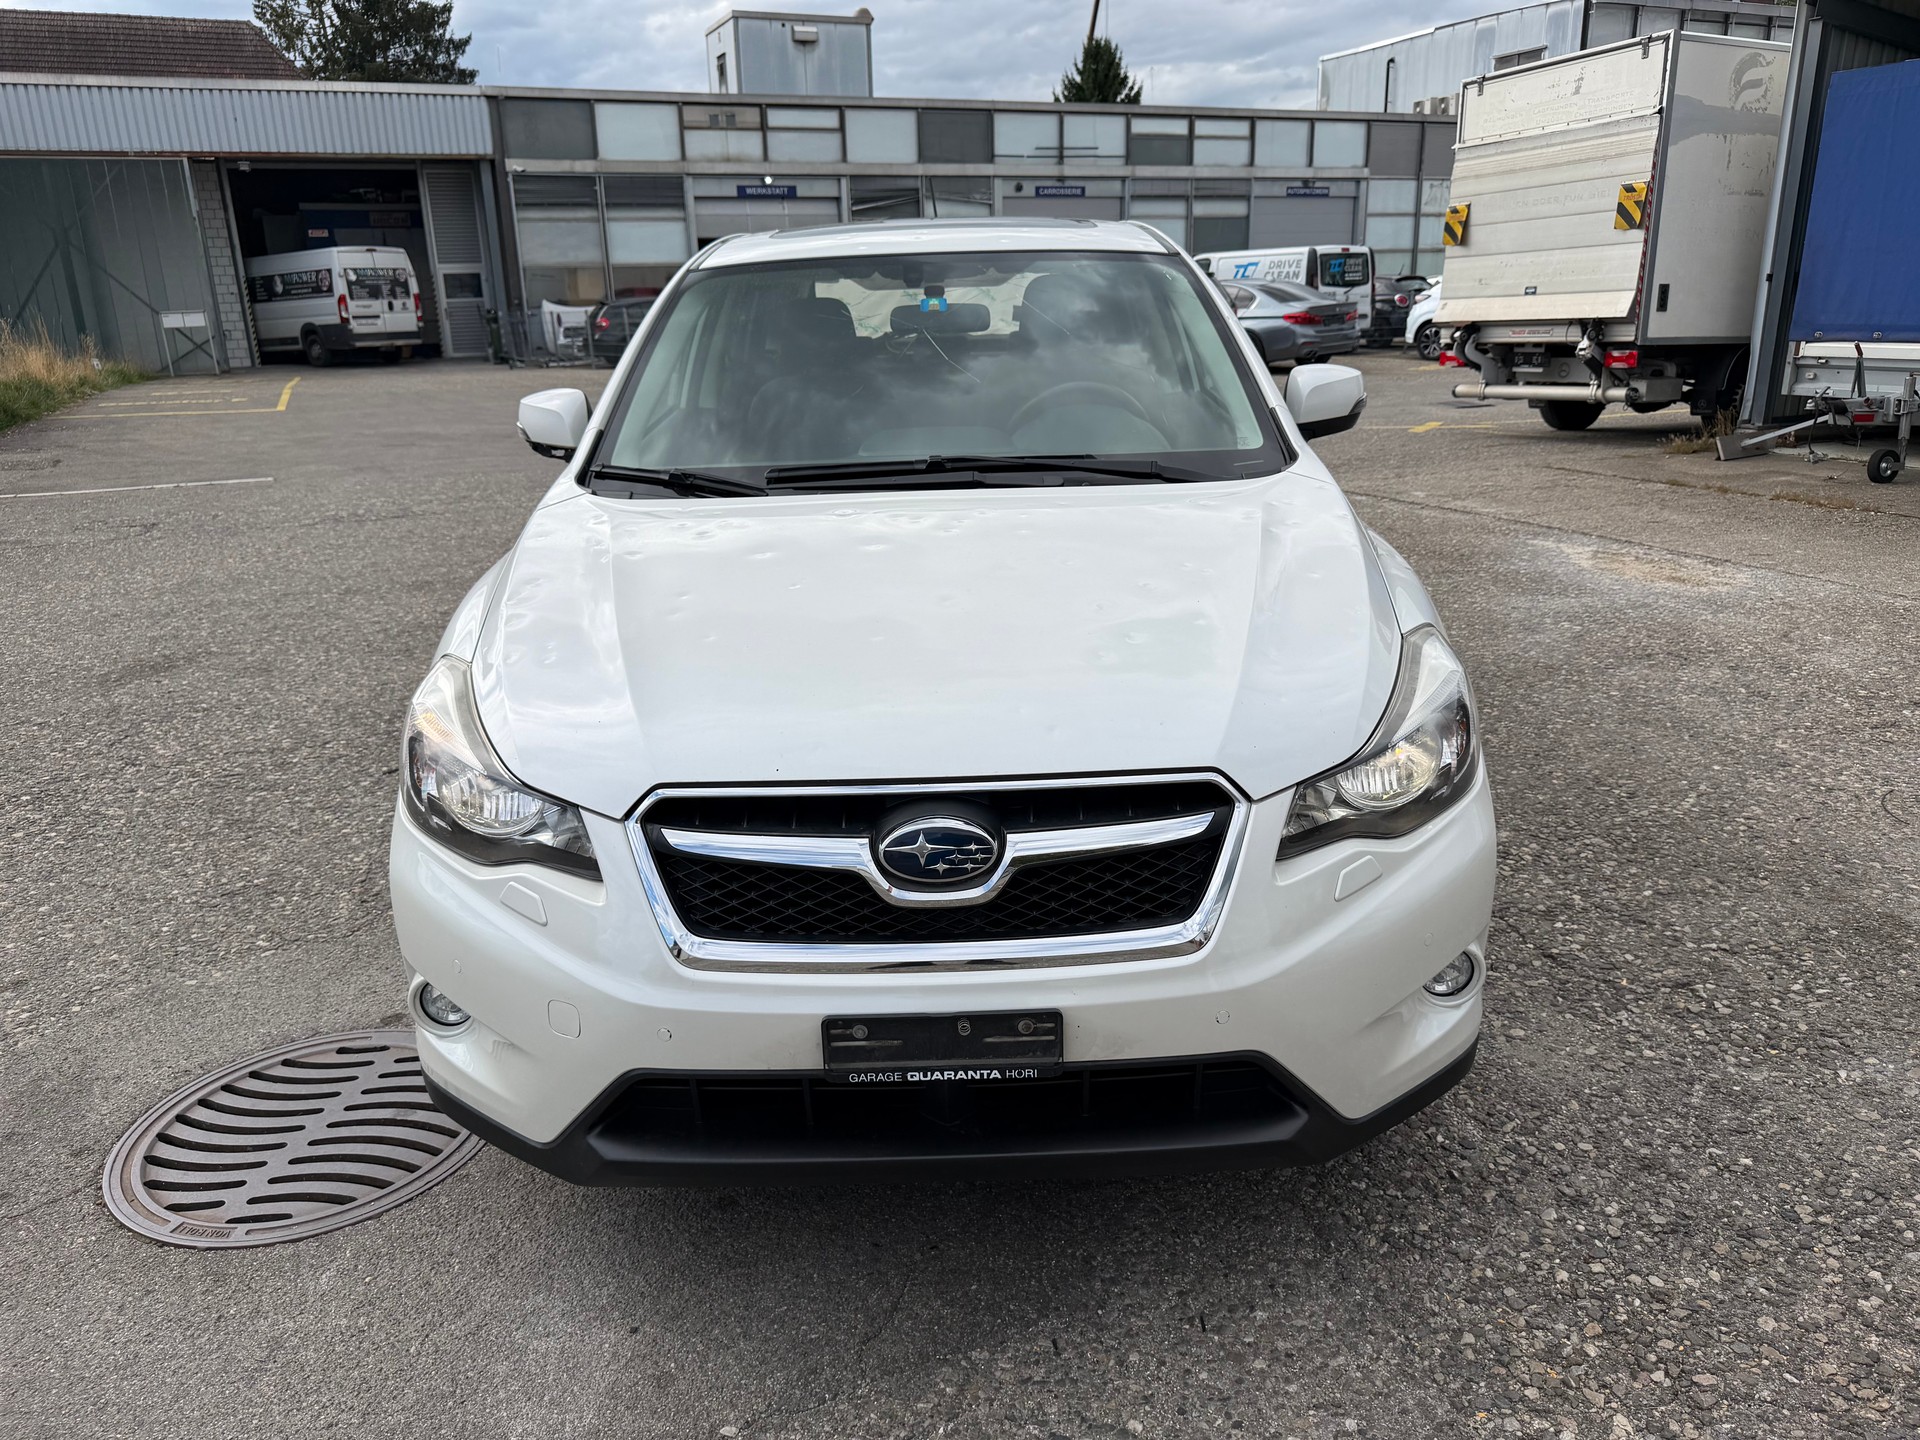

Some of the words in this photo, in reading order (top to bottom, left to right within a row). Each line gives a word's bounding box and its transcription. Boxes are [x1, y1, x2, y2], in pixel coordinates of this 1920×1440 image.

[745, 187, 789, 195] WERKSTATT
[1268, 259, 1303, 270] DRIVE
[1345, 258, 1363, 266] DRIVE
[1264, 270, 1301, 281] CLEAN
[848, 1071, 903, 1083] GARAGE
[906, 1069, 1002, 1081] QUARANTA
